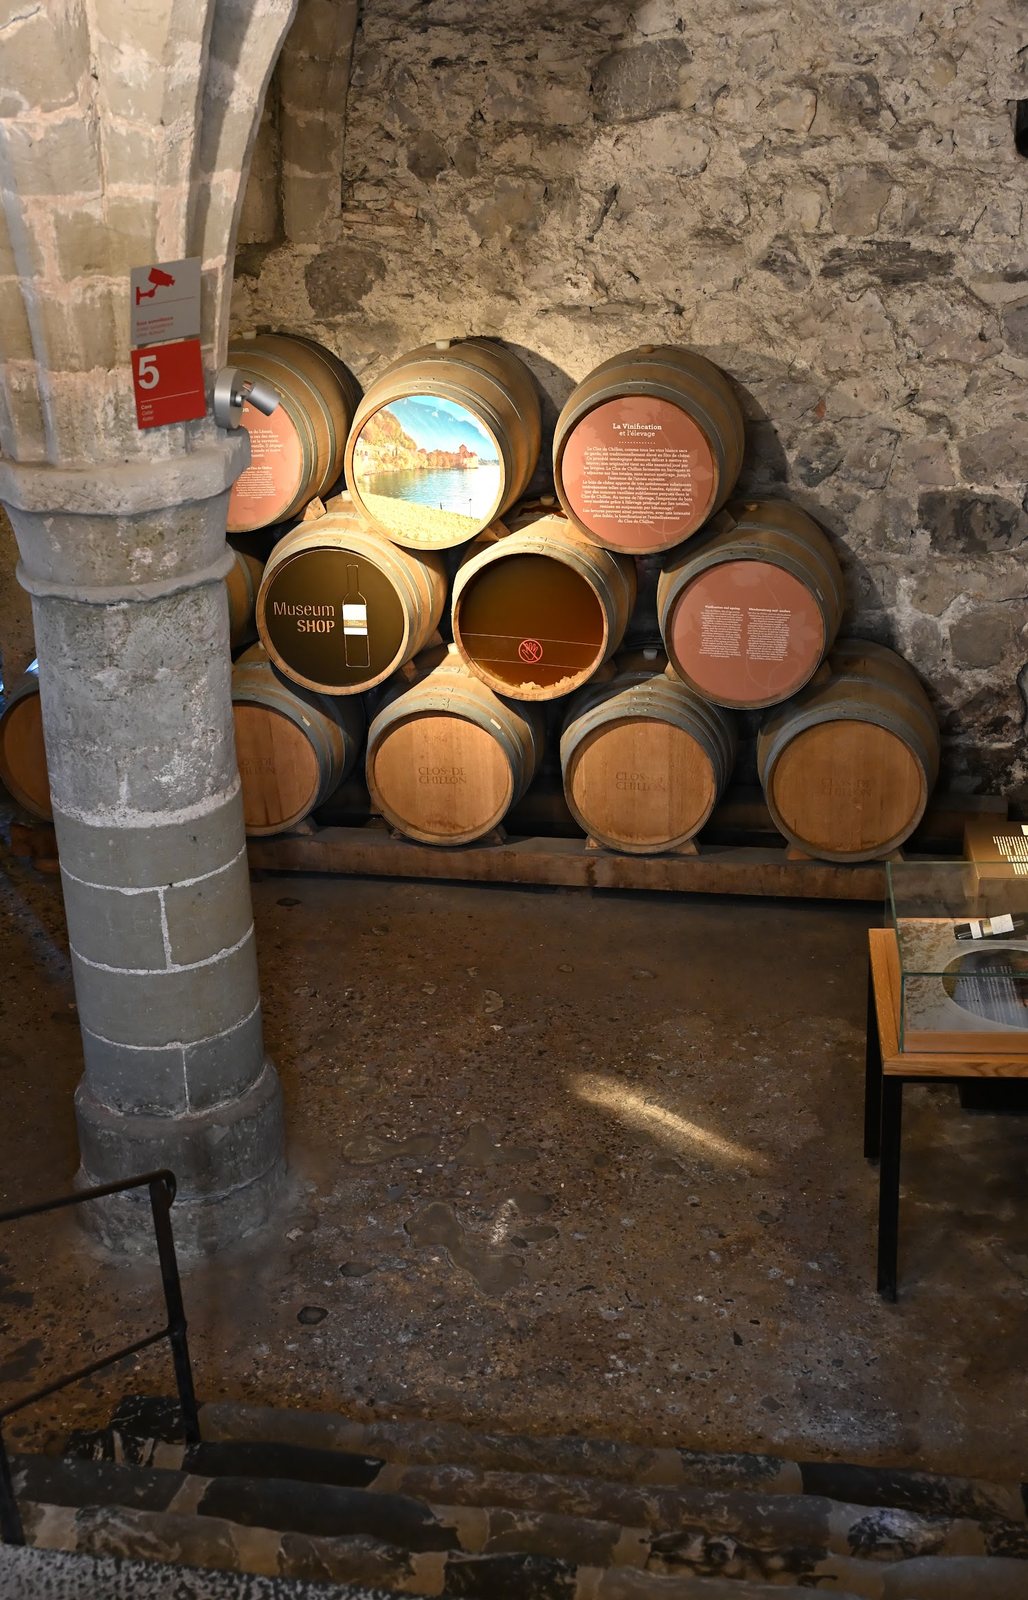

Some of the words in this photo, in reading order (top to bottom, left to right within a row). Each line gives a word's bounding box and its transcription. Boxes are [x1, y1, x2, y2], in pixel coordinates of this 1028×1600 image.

[138, 354, 159, 389] 5
[627, 429, 656, 438] l'élevage
[273, 601, 335, 617] Museum
[297, 619, 335, 633] SHOP
